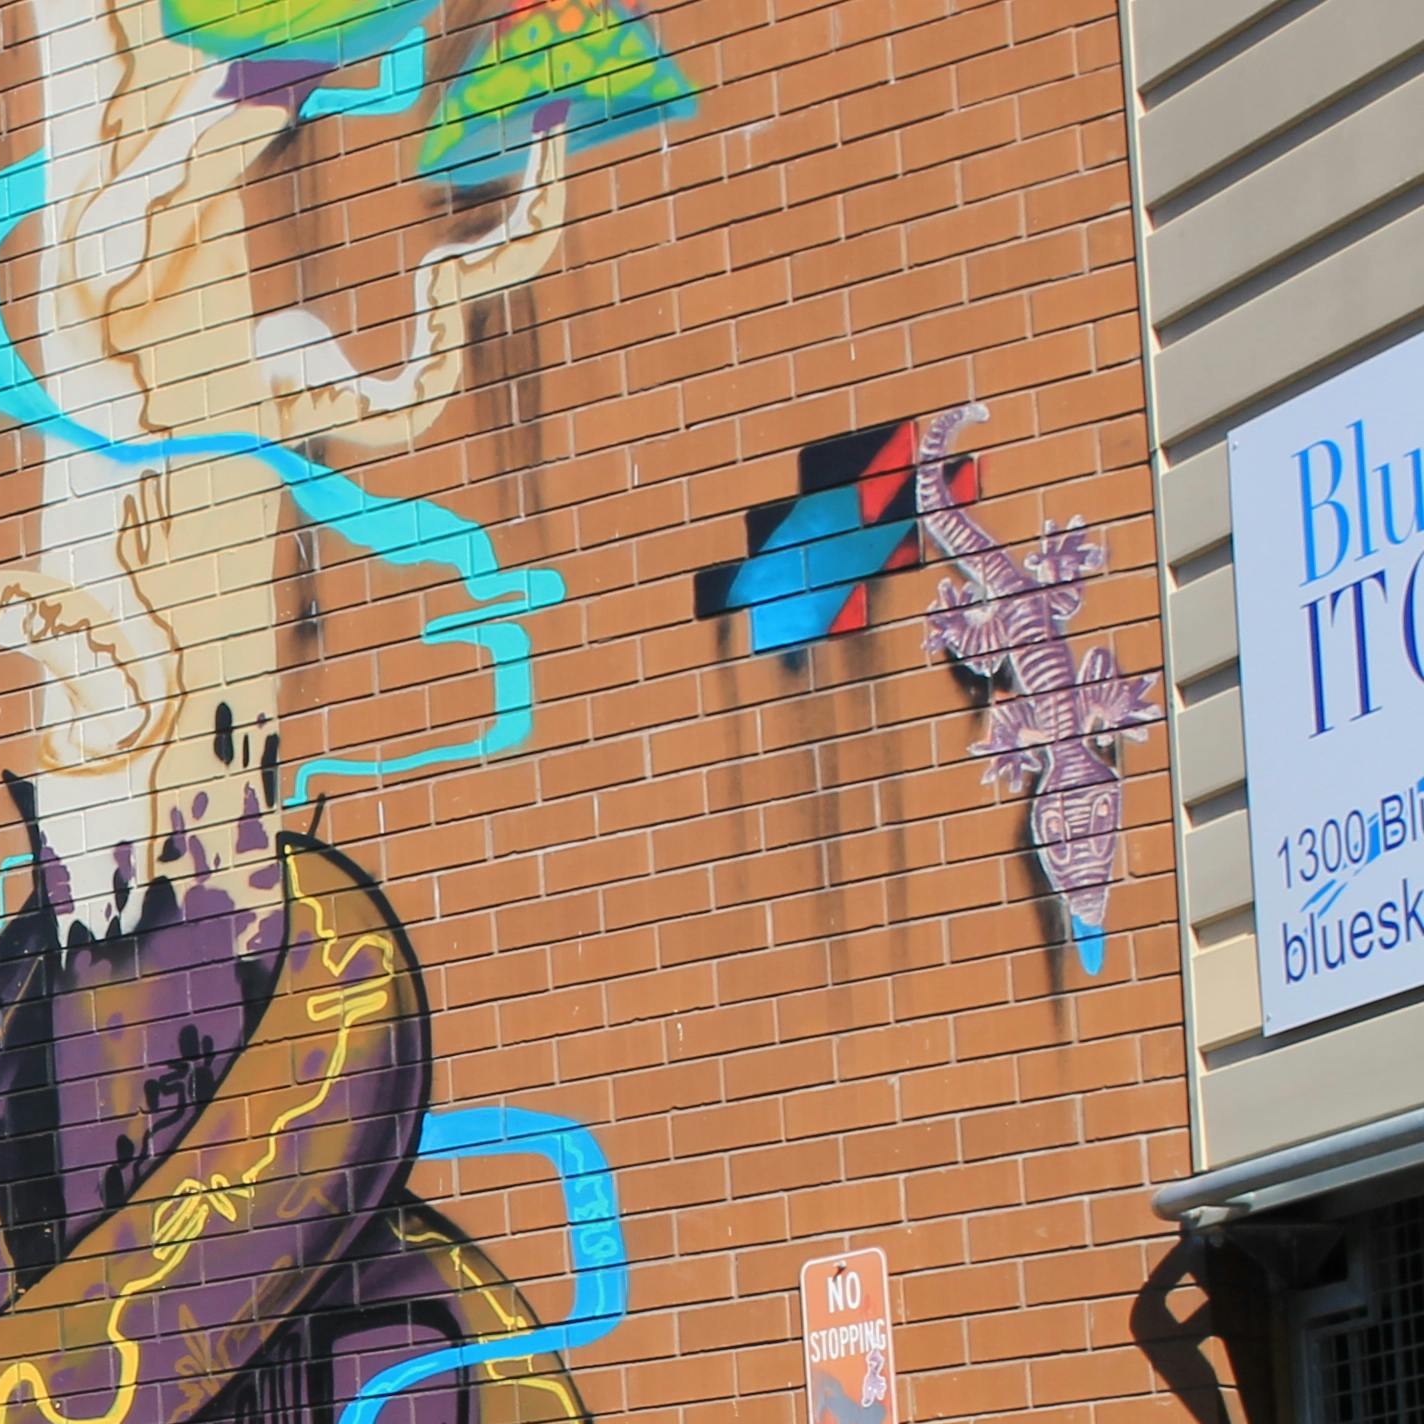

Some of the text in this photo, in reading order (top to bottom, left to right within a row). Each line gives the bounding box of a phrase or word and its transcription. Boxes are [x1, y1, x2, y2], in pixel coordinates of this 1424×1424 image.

[1278, 787, 1424, 889] 1300 Bl
[1282, 878, 1424, 985] bluesk
[826, 1271, 862, 1313] NO
[809, 1319, 887, 1363] STOPPING
